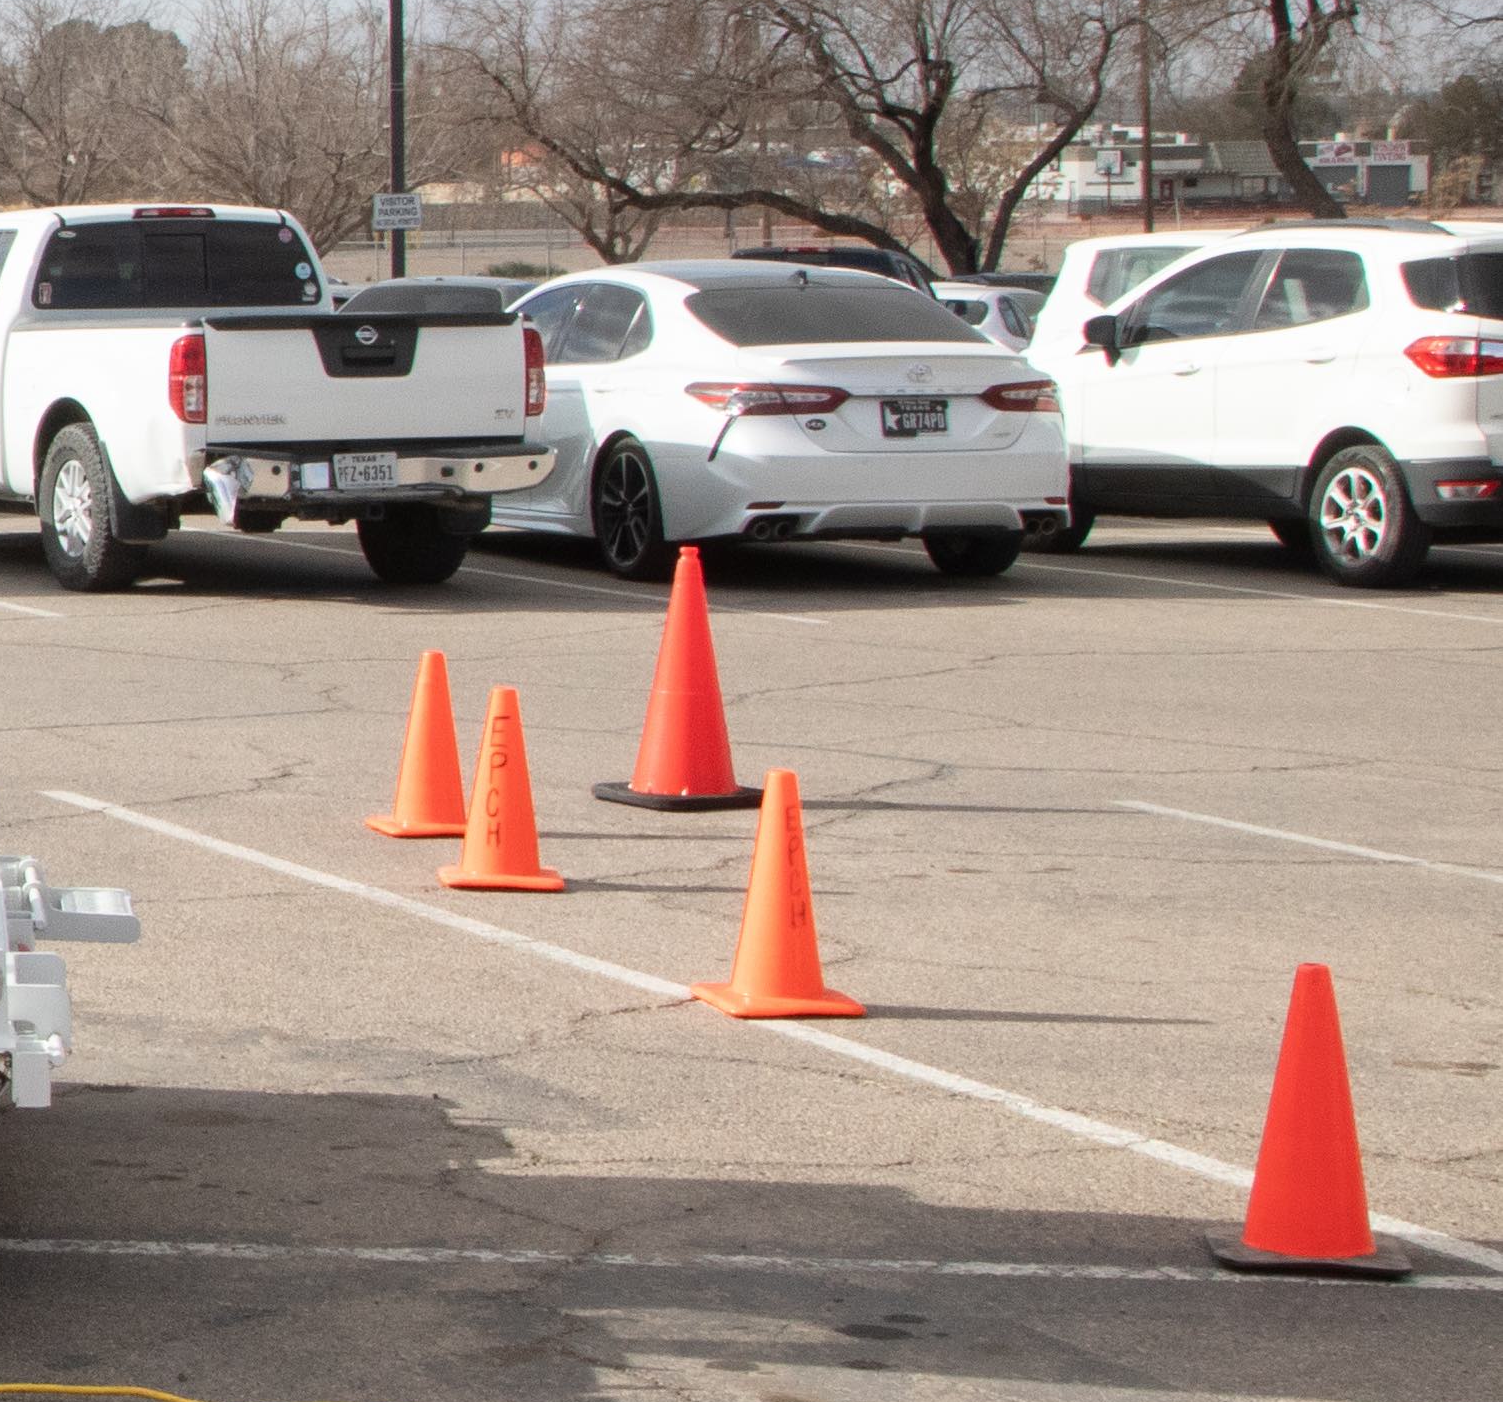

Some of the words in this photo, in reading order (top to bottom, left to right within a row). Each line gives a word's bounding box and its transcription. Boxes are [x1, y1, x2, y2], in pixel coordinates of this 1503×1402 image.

[379, 196, 416, 207] VISITOR
[377, 206, 418, 217] PARKING
[351, 455, 377, 463] TEXAS
